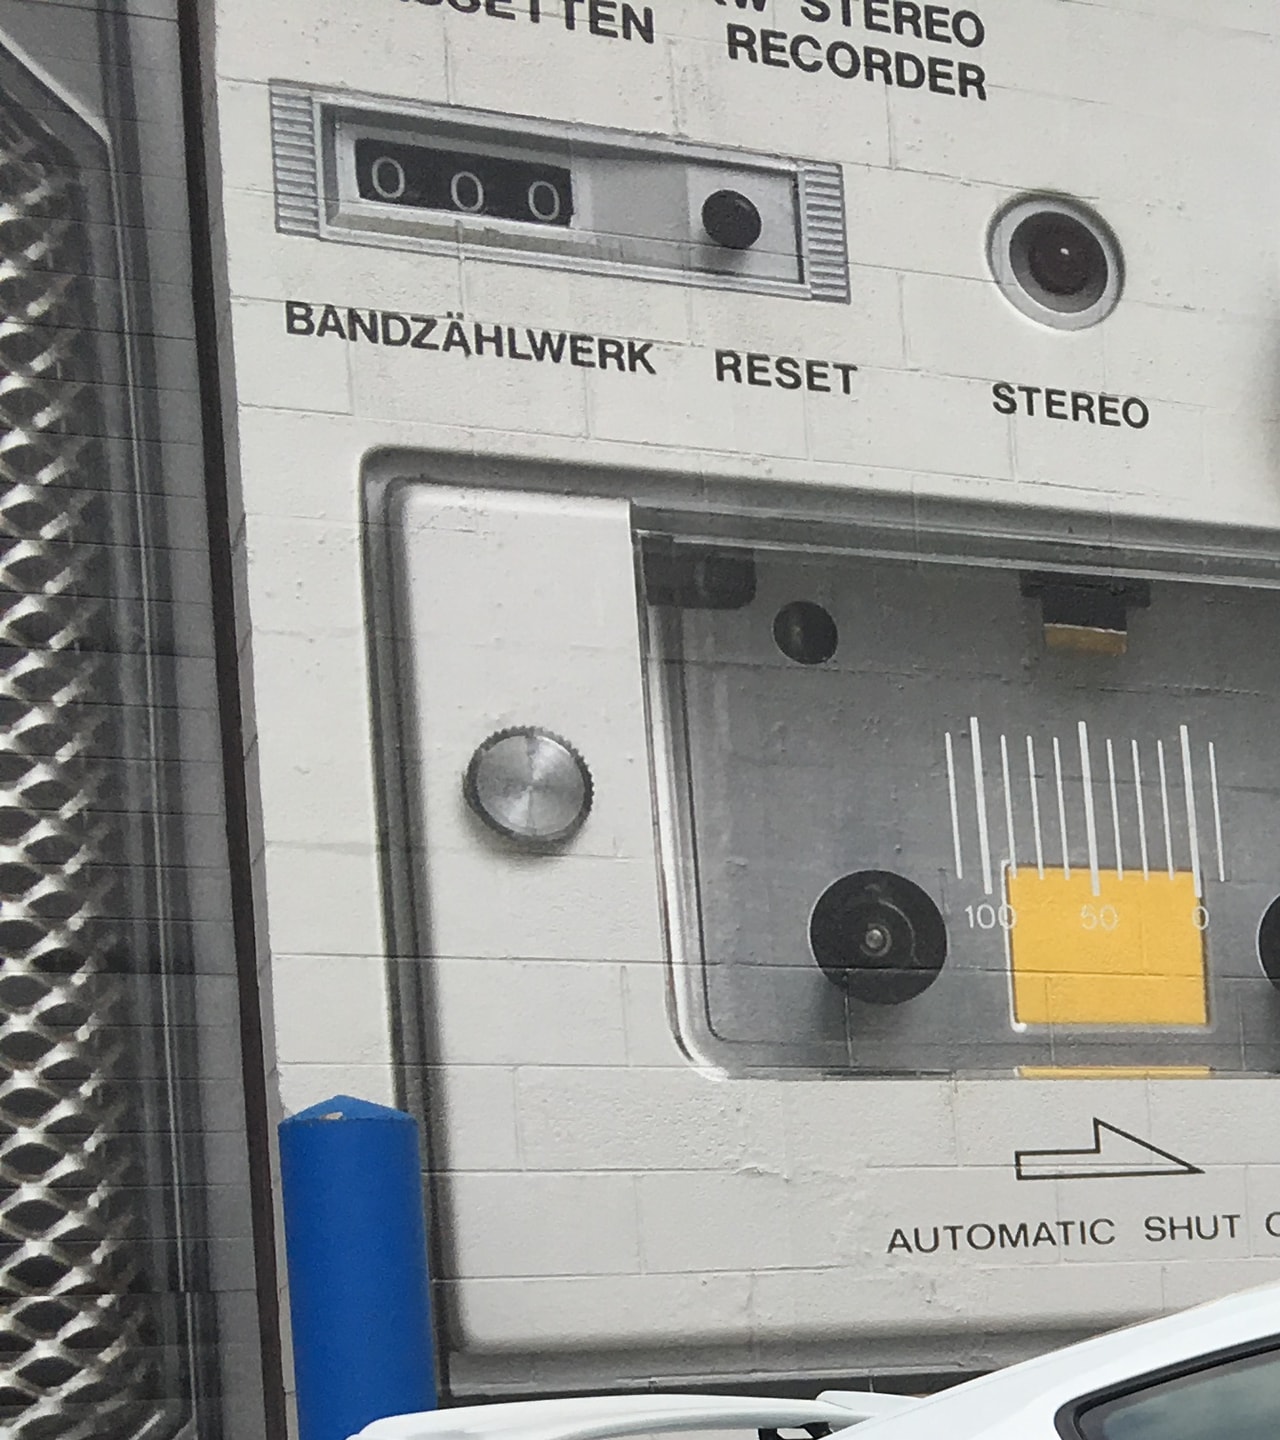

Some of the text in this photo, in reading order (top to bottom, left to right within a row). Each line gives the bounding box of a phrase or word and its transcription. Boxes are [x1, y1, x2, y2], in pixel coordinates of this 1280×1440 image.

[800, 0, 985, 48] STEREO
[727, 23, 984, 101] RECORDER
[285, 300, 859, 395] BANDZÄHLWERK RESET
[992, 381, 1149, 429] STEREO
[965, 904, 1209, 930] 100 50 0
[887, 1217, 1116, 1254] AUTOMATIC
[1144, 1213, 1241, 1242] SHUT
